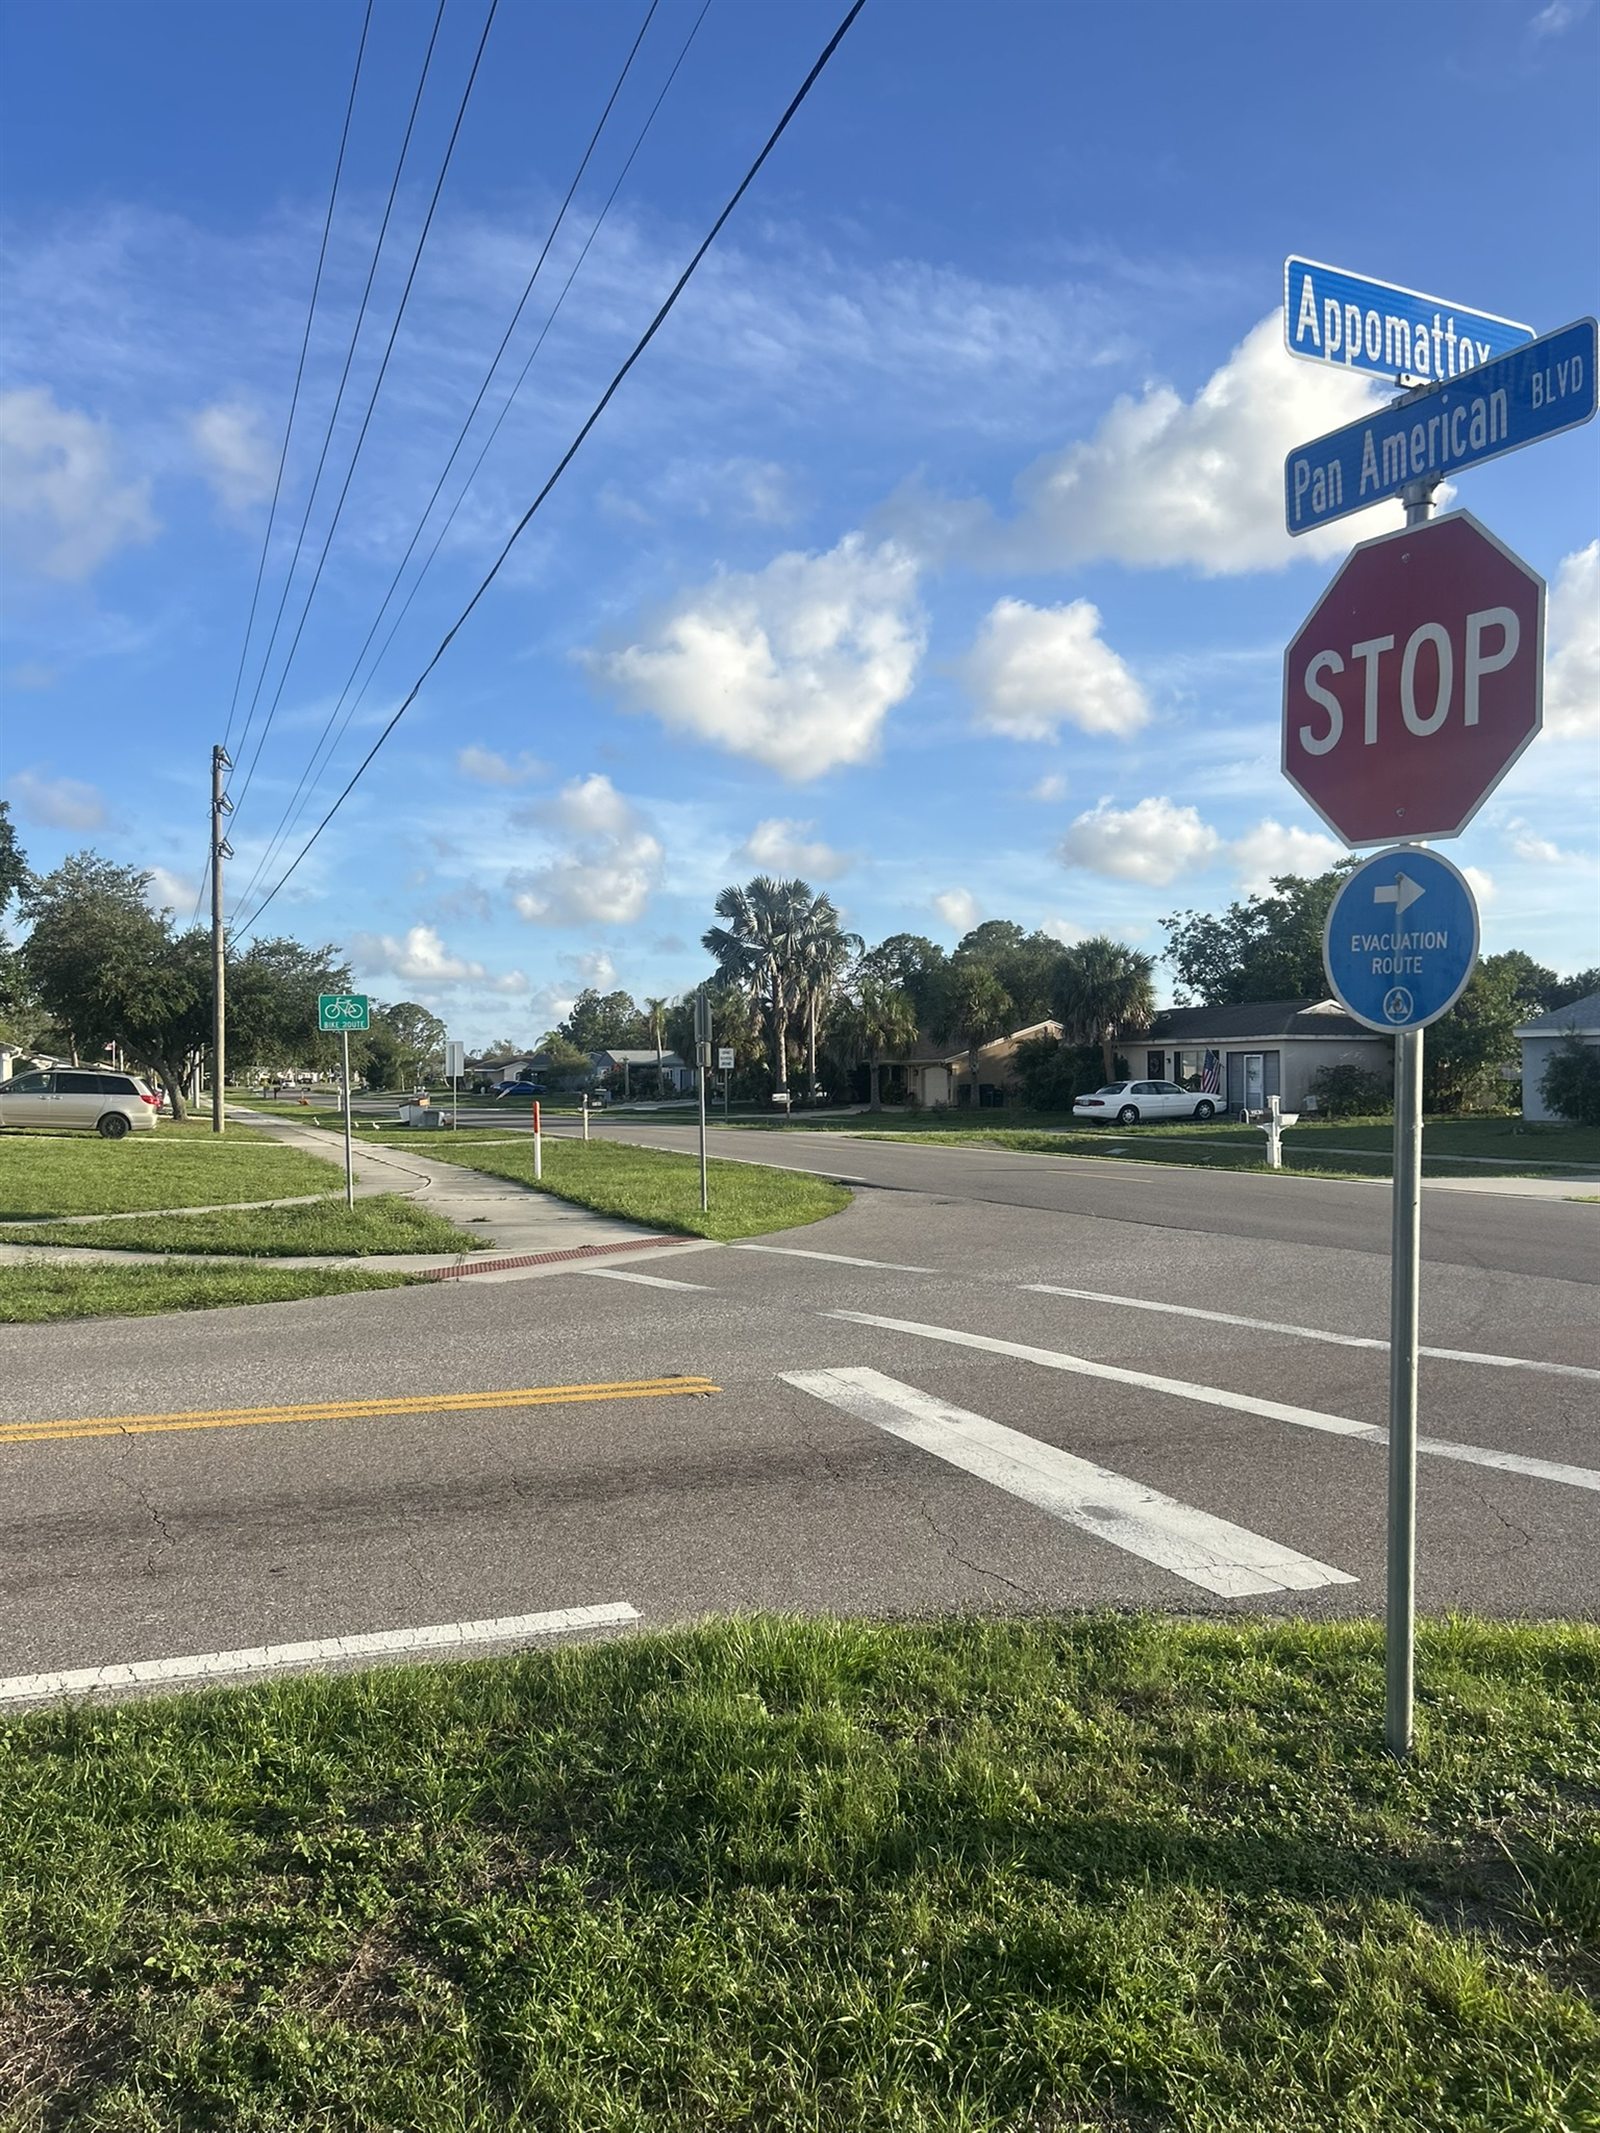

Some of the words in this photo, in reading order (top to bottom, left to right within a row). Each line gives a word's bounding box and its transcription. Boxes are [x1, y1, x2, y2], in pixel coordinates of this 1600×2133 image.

[1294, 459, 1343, 520] Pan
[1359, 387, 1508, 495] American
[1532, 355, 1583, 409] BLVD
[1299, 606, 1520, 756] STOP
[1351, 931, 1448, 952] EVACUATION
[1372, 956, 1423, 975] ROUTE
[323, 1021, 340, 1029] BIKE
